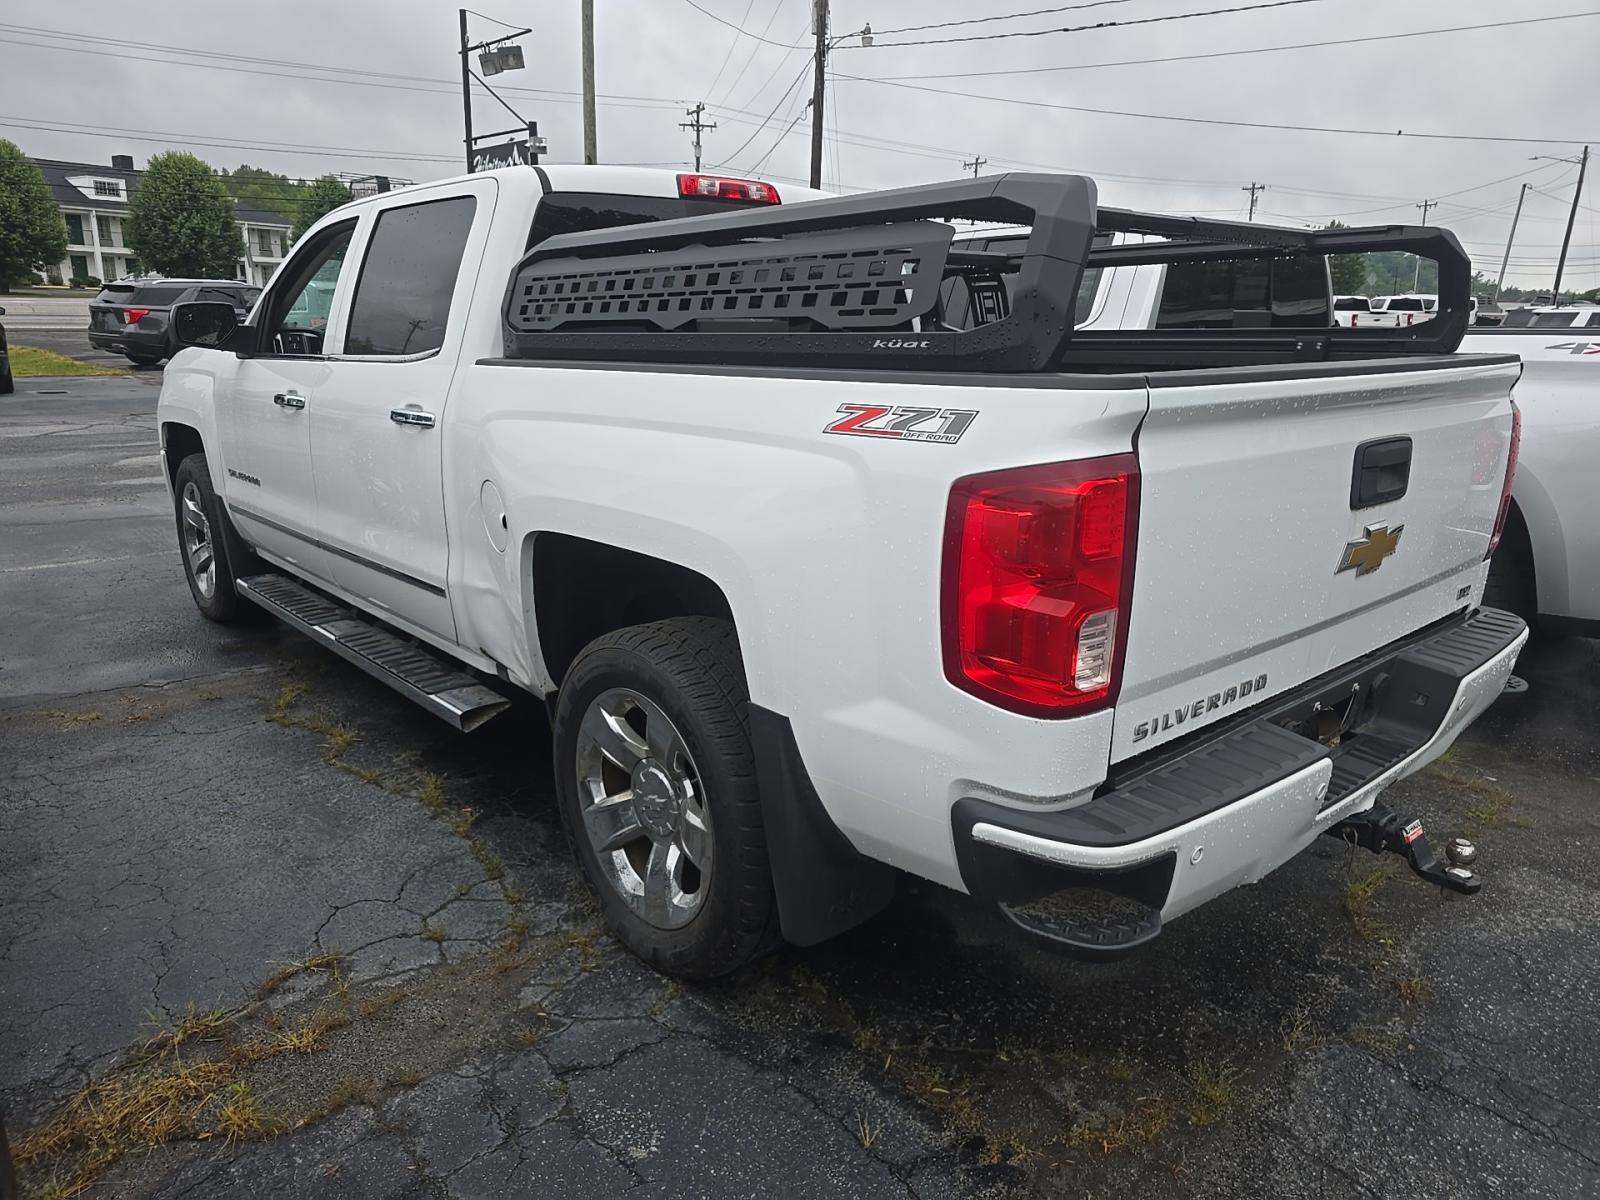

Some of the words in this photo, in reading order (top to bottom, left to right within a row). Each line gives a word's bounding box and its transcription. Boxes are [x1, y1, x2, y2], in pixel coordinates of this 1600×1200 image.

[873, 339, 930, 349] küat
[822, 403, 980, 442] Z71
[903, 432, 926, 440] OFF
[926, 433, 957, 442] ROAD
[1133, 673, 1268, 743] SILVERADO
